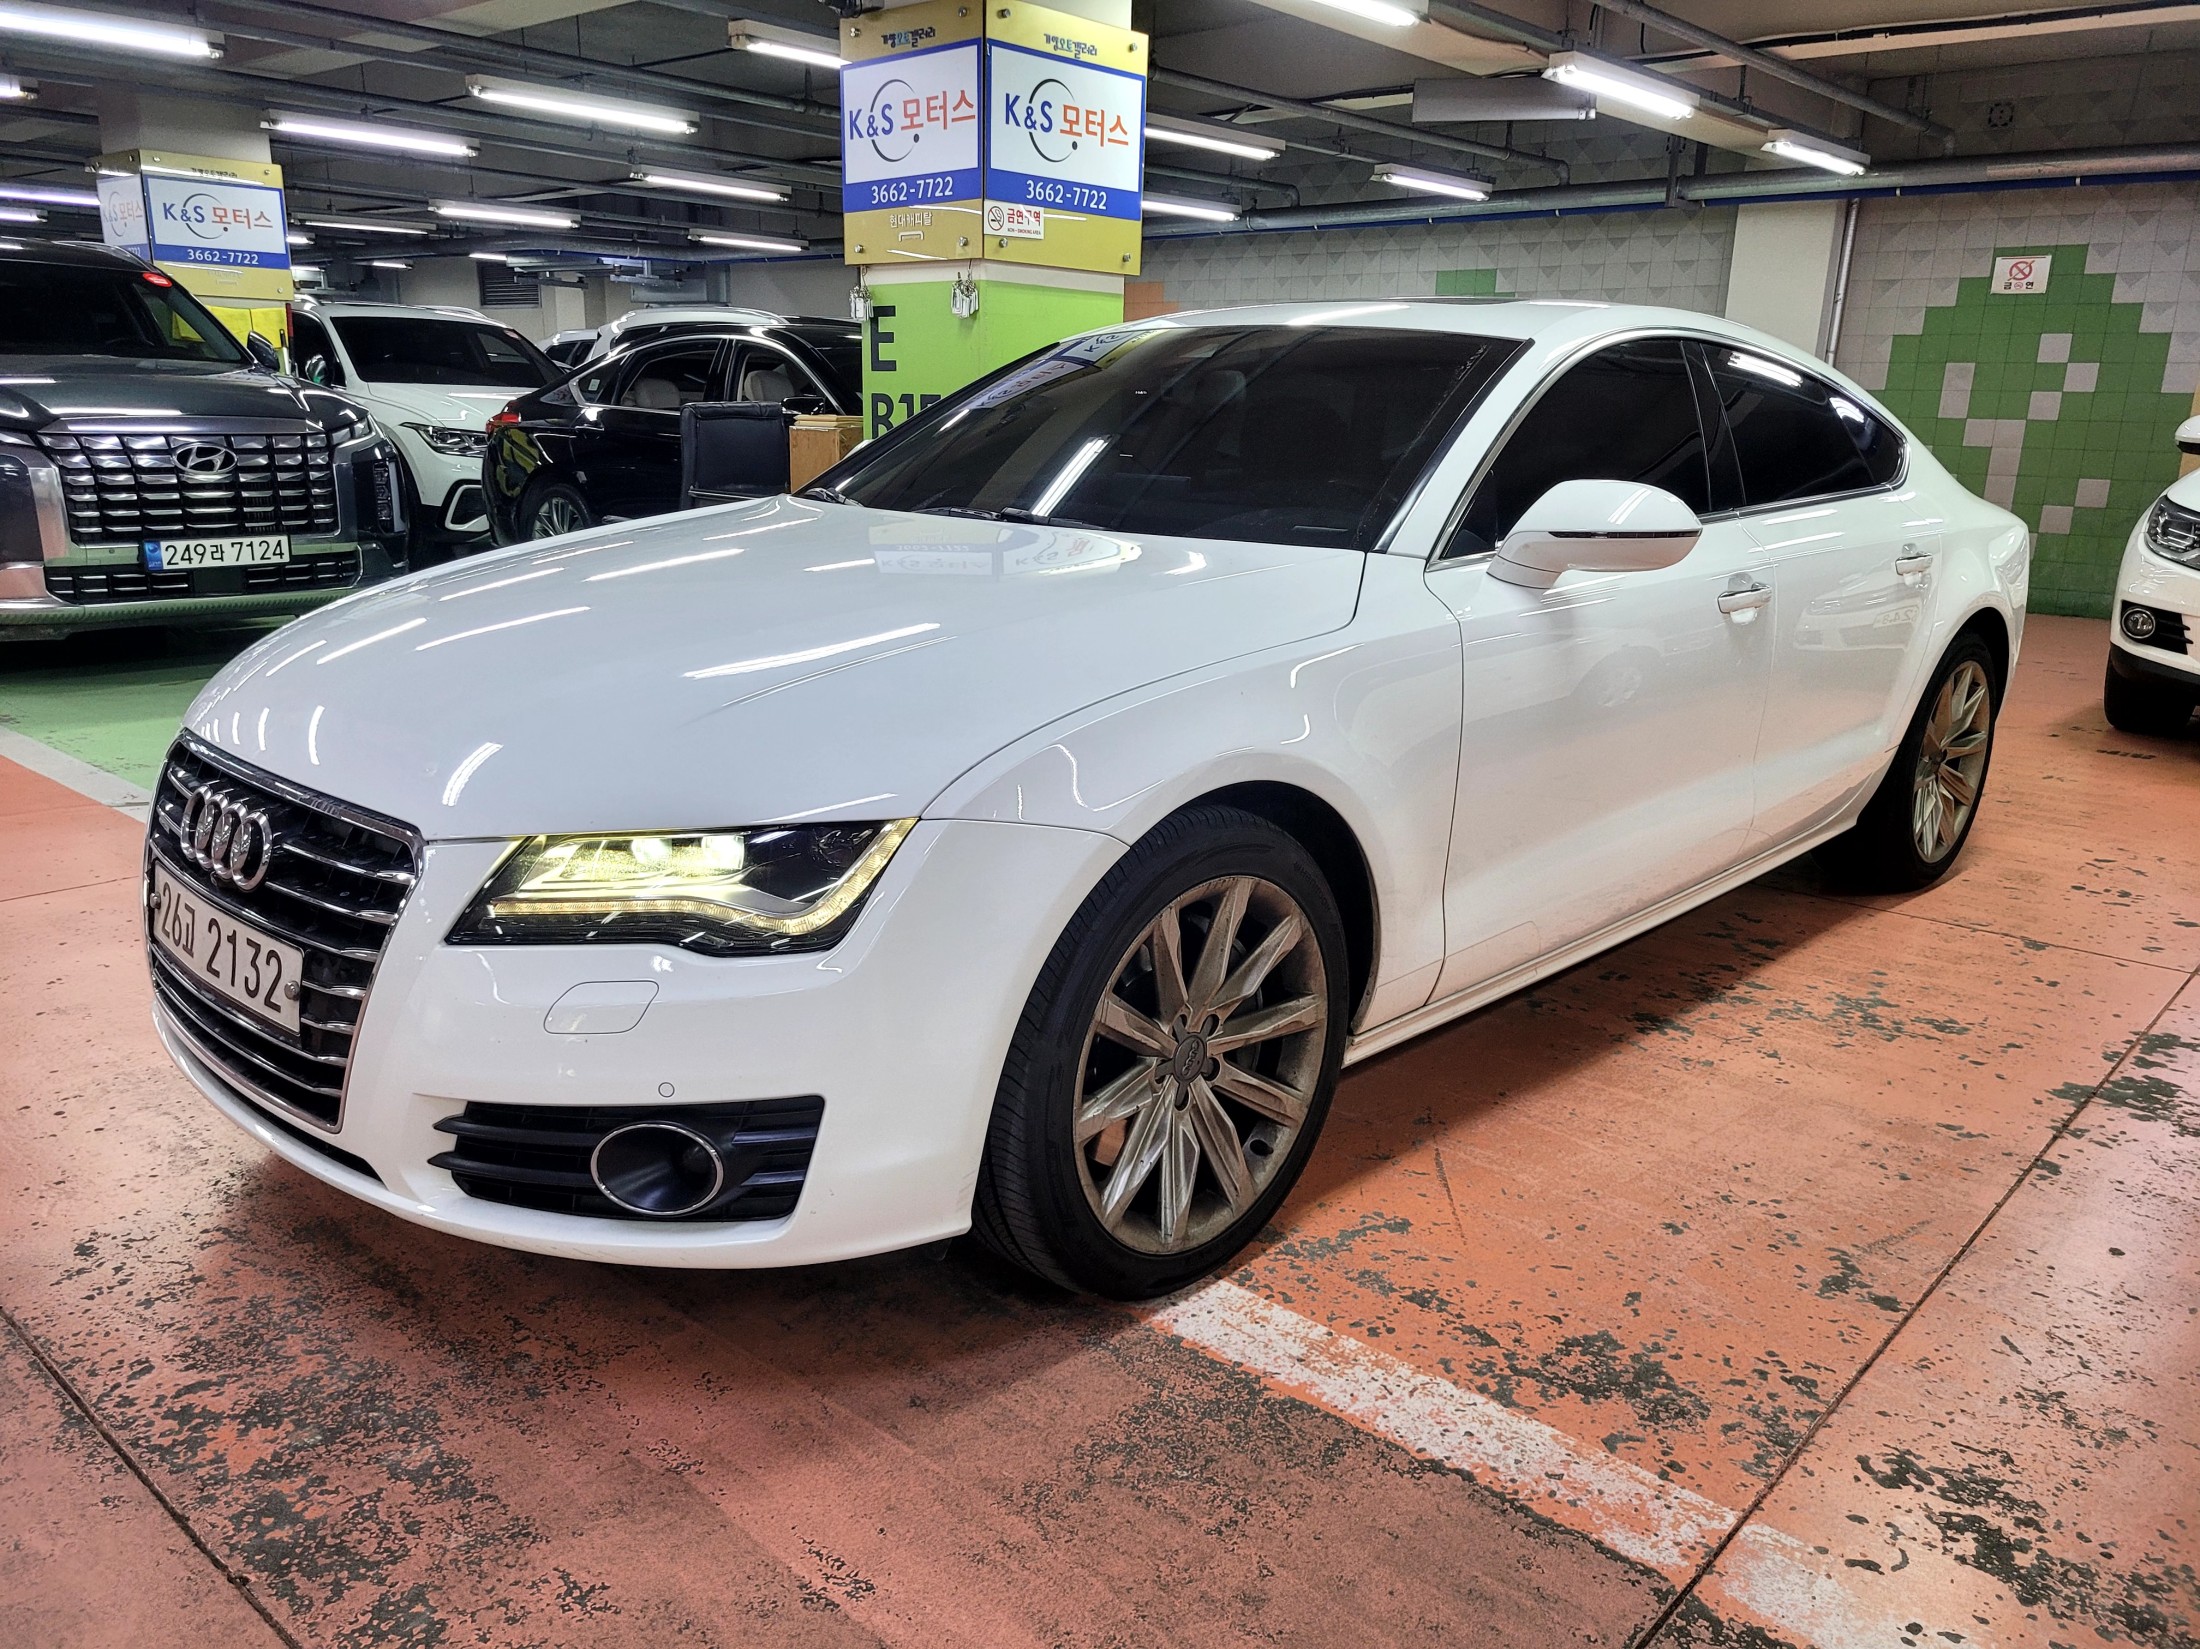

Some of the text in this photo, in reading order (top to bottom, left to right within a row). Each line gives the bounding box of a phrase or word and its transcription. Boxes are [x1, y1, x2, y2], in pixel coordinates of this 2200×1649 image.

[849, 90, 976, 140] K&S 모터스
[1005, 93, 1129, 147] K&S 모터스
[871, 176, 953, 205] 3662-7722
[1026, 180, 1107, 210] 3662-7722
[163, 203, 273, 229] K&S 모터스
[889, 211, 933, 229] 현대캐피탈
[187, 250, 259, 265] 3662-7722
[870, 305, 897, 372] E
[164, 539, 285, 566] 249라 7124
[206, 917, 283, 1014] 2132
